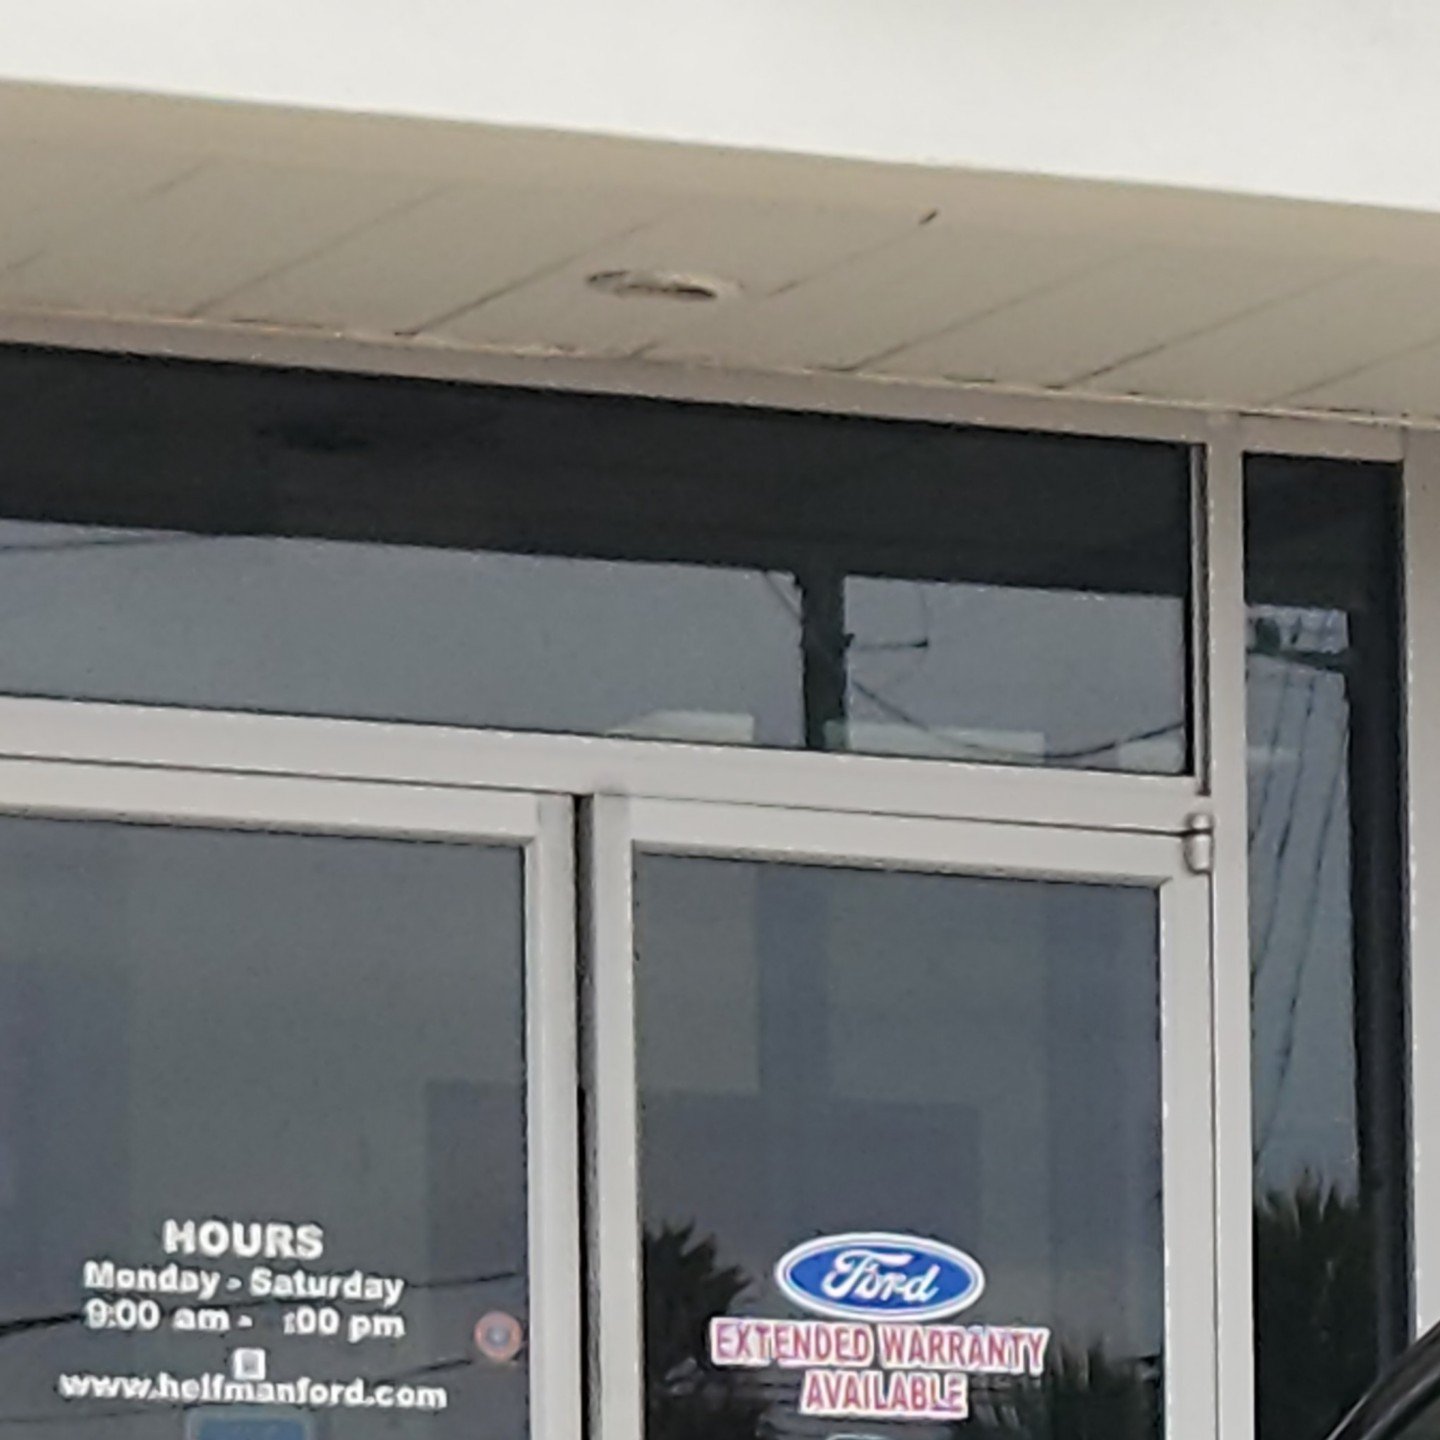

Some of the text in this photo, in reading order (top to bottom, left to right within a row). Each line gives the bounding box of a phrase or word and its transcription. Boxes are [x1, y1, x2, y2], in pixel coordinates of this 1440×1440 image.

[163, 1219, 324, 1260] HOURS
[83, 1260, 220, 1299] Monday
[249, 1267, 405, 1307] Saturday
[821, 1248, 941, 1303] Ford
[85, 1298, 160, 1330] 9:00
[173, 1307, 230, 1331] am
[348, 1312, 406, 1342] pm
[714, 1322, 1047, 1371] EXTENDED WARRANTY
[58, 1372, 448, 1410] www.helfmanford.com
[805, 1372, 964, 1412] AVAILABLE
